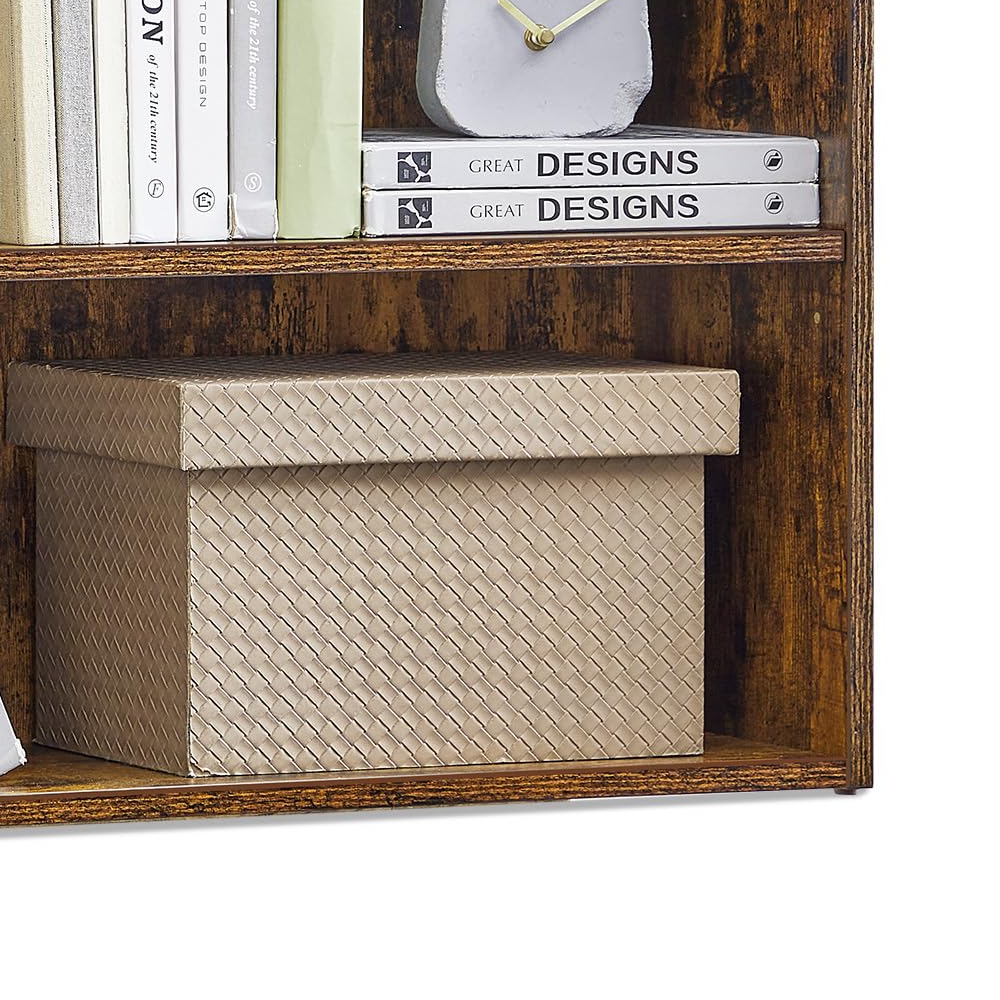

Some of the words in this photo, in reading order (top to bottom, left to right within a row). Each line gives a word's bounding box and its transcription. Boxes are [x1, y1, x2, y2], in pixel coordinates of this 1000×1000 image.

[199, 1, 207, 35] TOP
[248, 0, 260, 16] of
[249, 17, 260, 35] the
[147, 54, 159, 69] of
[248, 36, 260, 65] 21th
[149, 71, 160, 89] the
[199, 42, 207, 108] DESIGN
[246, 67, 258, 110] century
[149, 91, 160, 117] 21th
[148, 120, 158, 163] century
[469, 159, 524, 173] GREAT
[537, 150, 699, 177] DESIGNS
[469, 204, 525, 219] GREAT
[538, 194, 700, 222] DESIGNS
